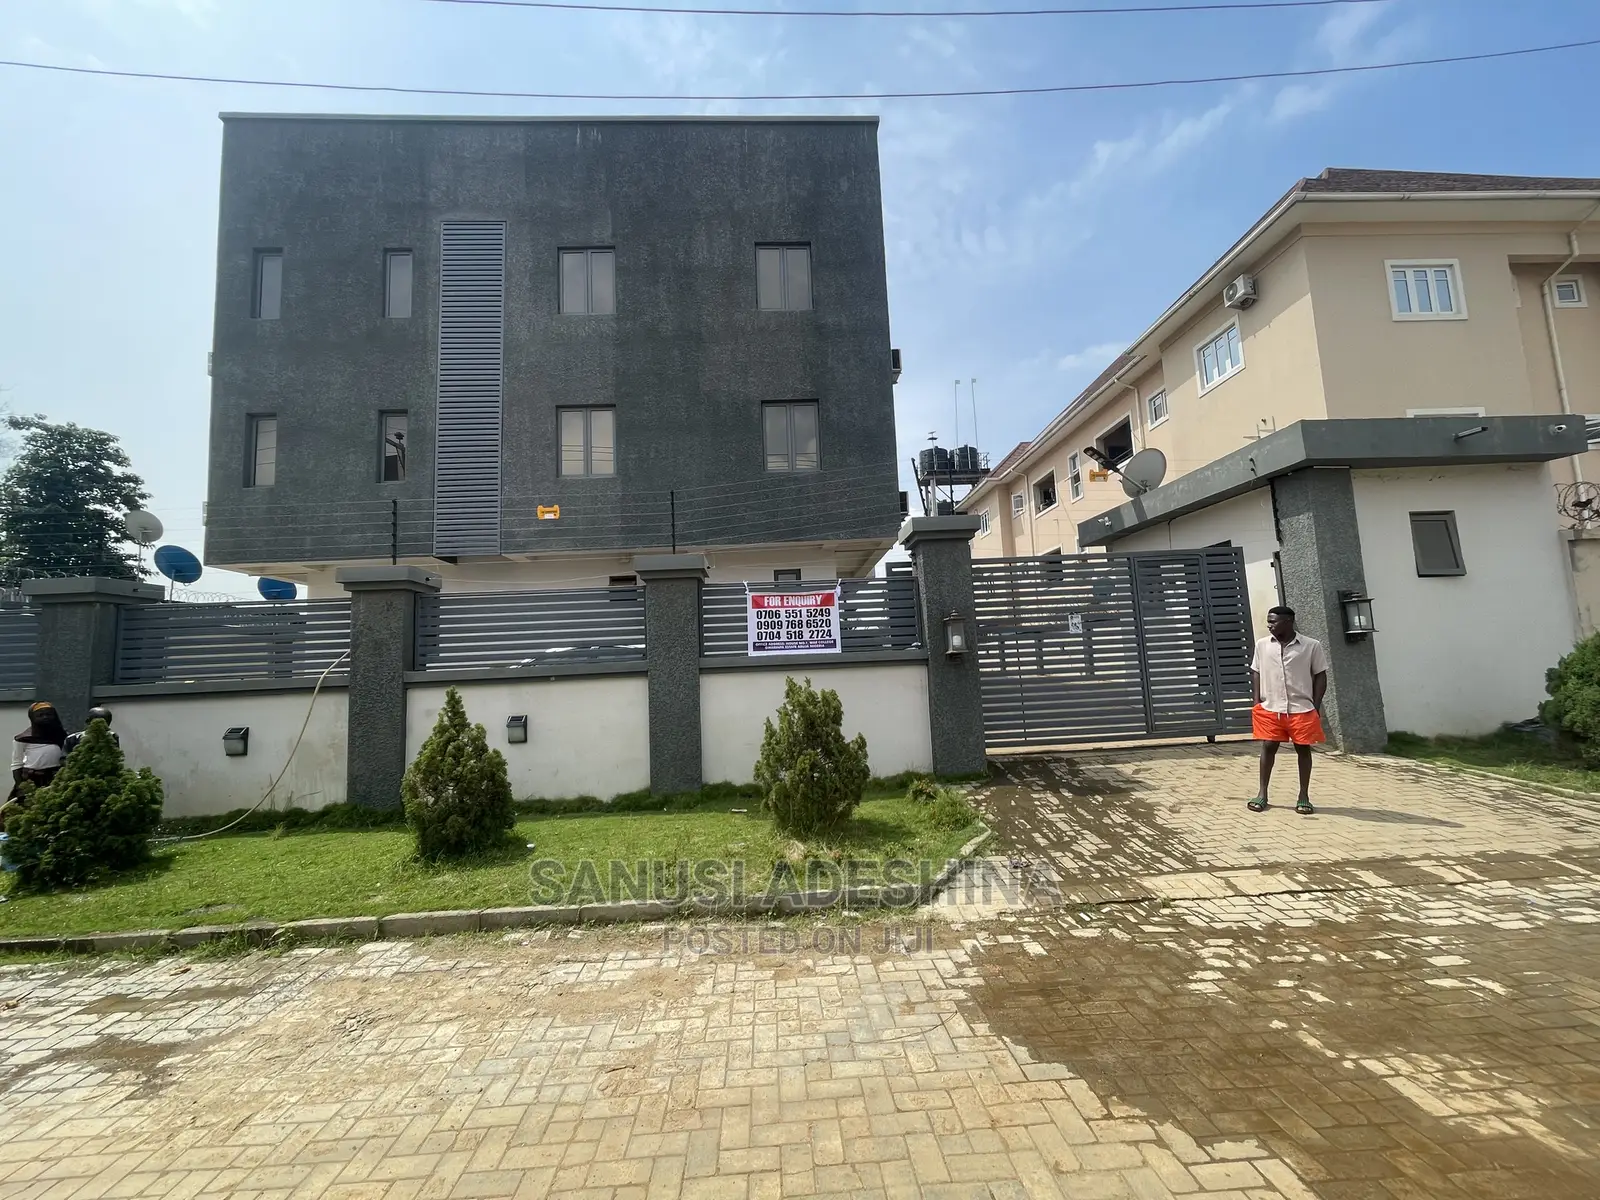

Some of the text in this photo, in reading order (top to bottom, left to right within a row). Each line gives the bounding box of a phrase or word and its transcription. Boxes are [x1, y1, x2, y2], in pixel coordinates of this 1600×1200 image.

[764, 595, 823, 607] FOR ENQUIRY
[756, 608, 831, 620] 0706 551 5249
[756, 618, 831, 631] 0909 768 6520
[757, 629, 832, 641] 0704 518 2724
